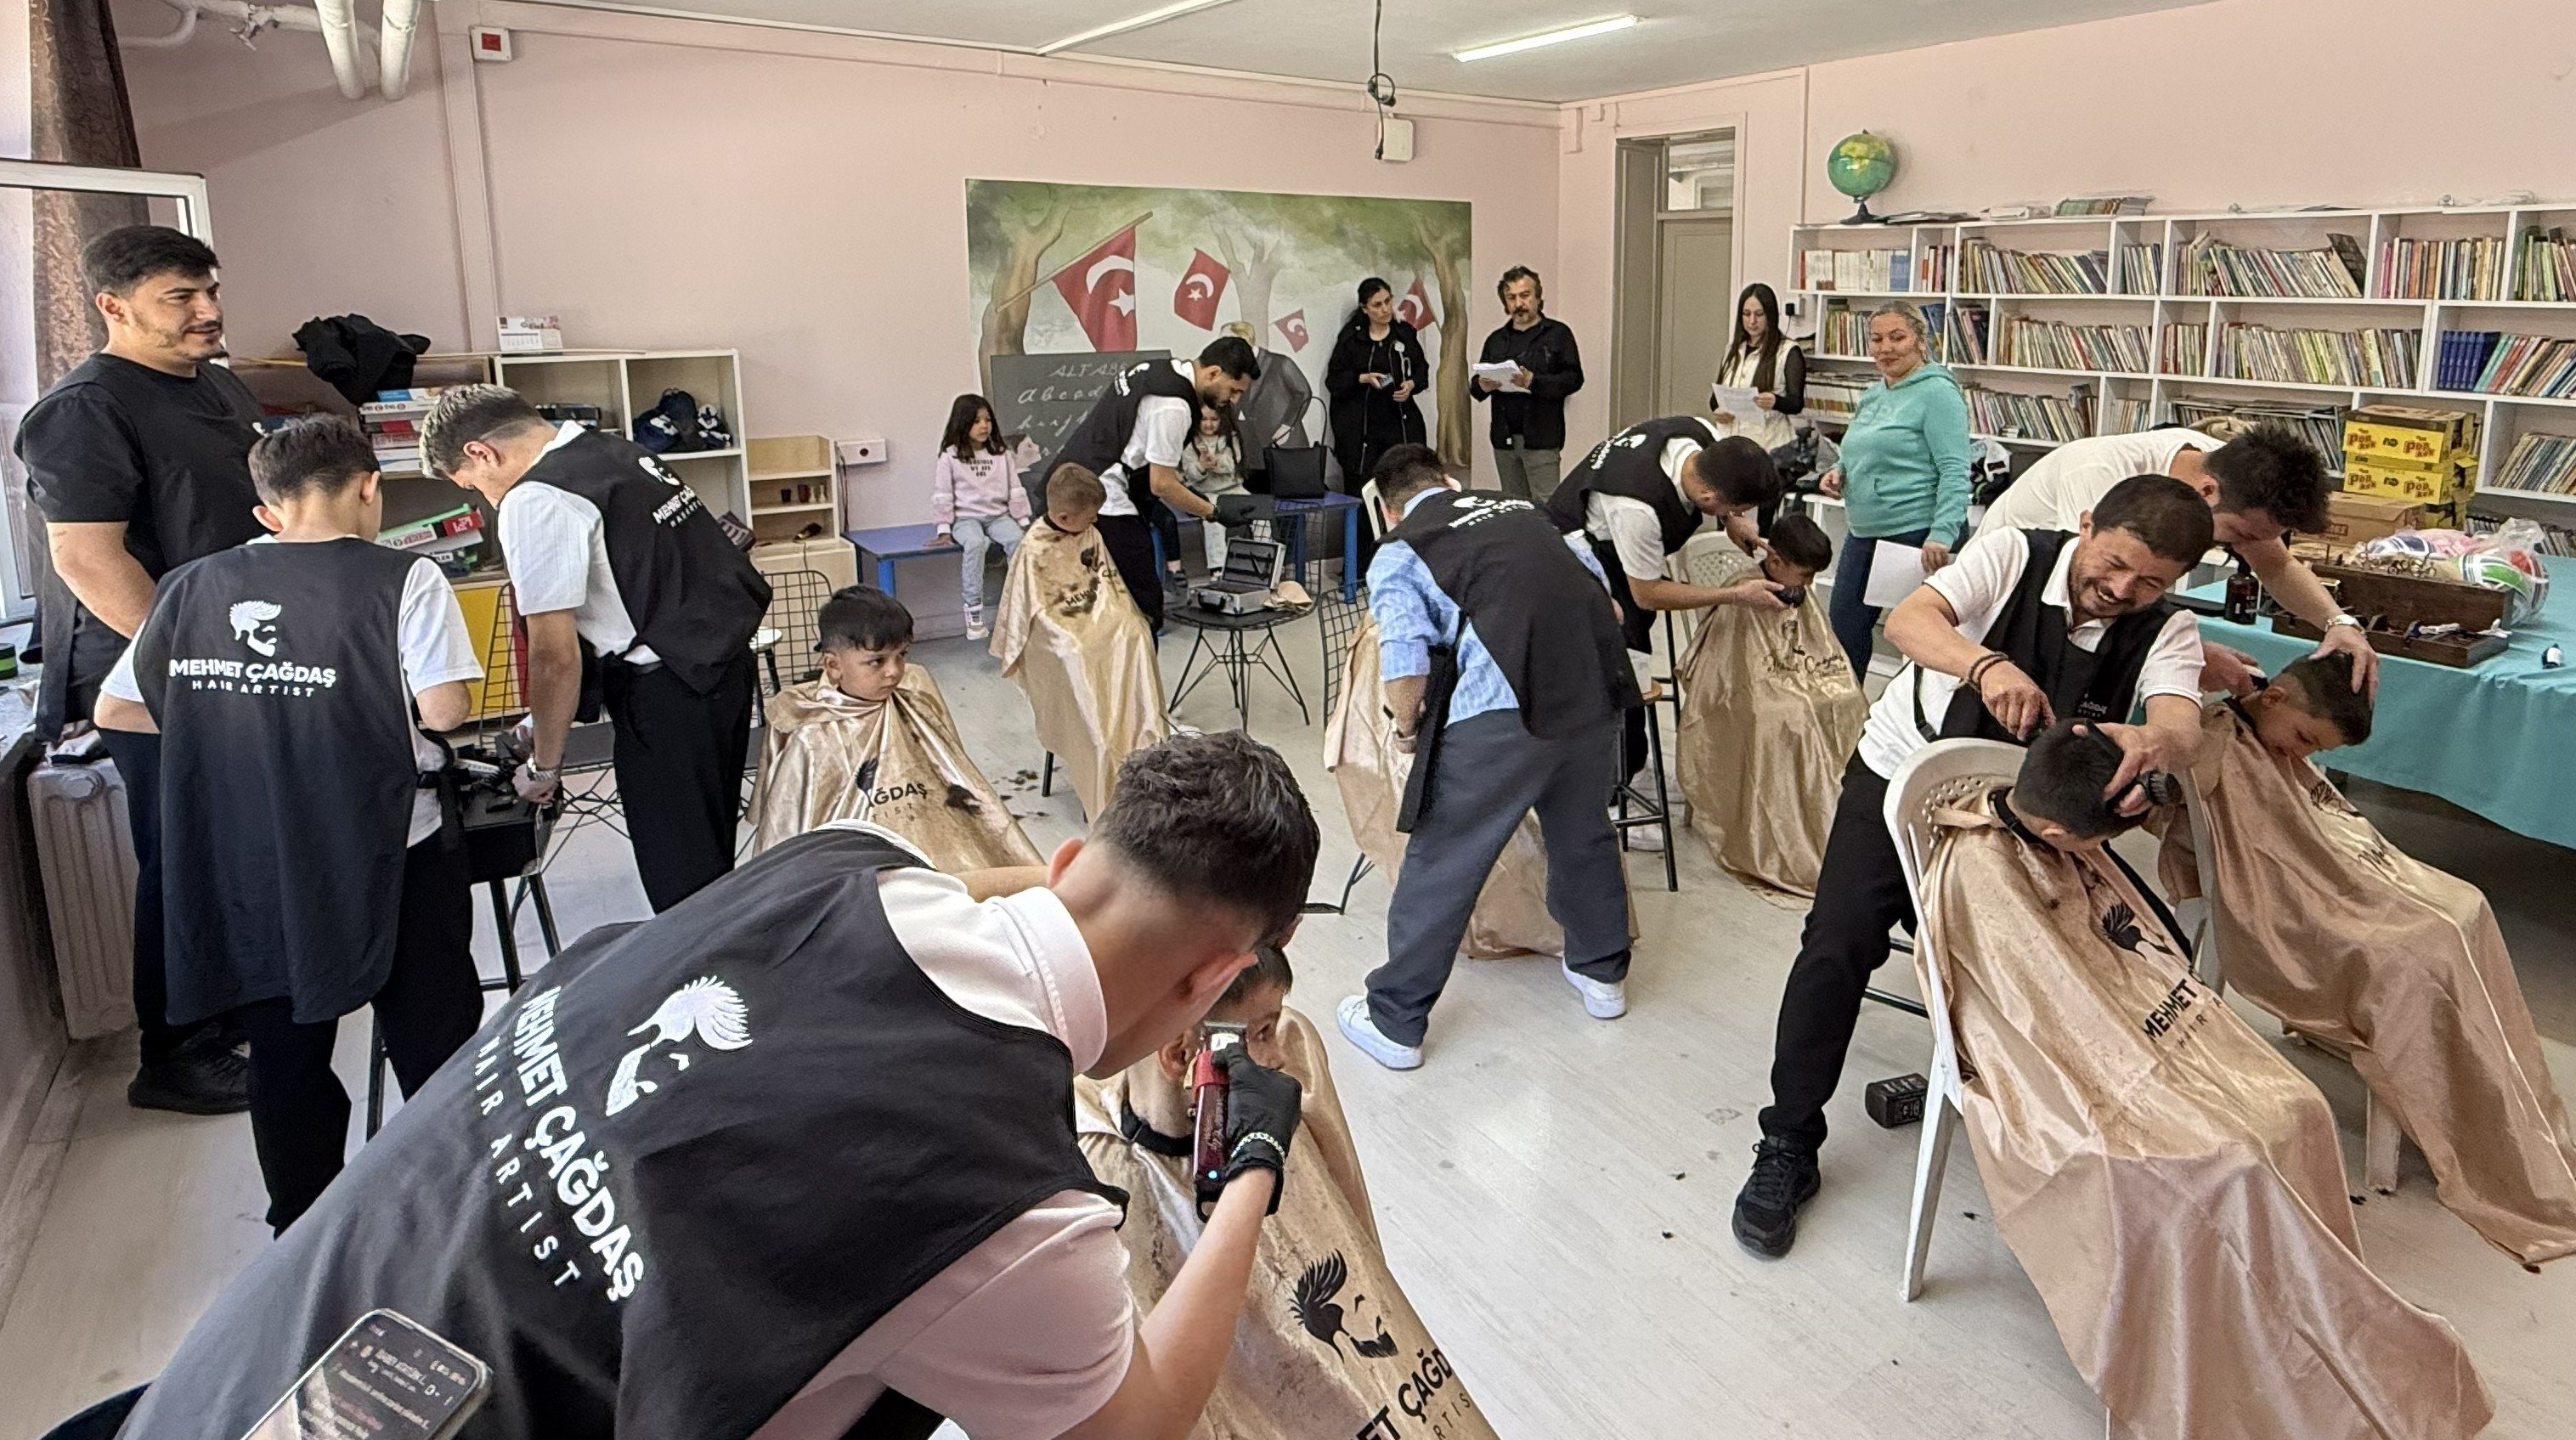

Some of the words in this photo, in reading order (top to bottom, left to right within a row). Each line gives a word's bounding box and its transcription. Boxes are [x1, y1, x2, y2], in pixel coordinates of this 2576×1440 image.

[169, 658, 244, 679] MEHMET
[246, 662, 336, 687] ÇAĞDAŞ
[192, 680, 233, 692] HAIR
[240, 685, 314, 697] ARTIST
[867, 783, 927, 807] ĞDAŞ
[2143, 979, 2198, 1043] MEHMET
[2177, 1014, 2208, 1049] HAIR
[513, 985, 568, 1107] MEHMET
[475, 1036, 504, 1115] HAIR
[490, 1133, 581, 1286] ARTIST
[524, 1105, 644, 1302] ÇAĞDAŞ
[1398, 1348, 1453, 1424] ÇAĞD
[1433, 1392, 1471, 1440] RTIS
